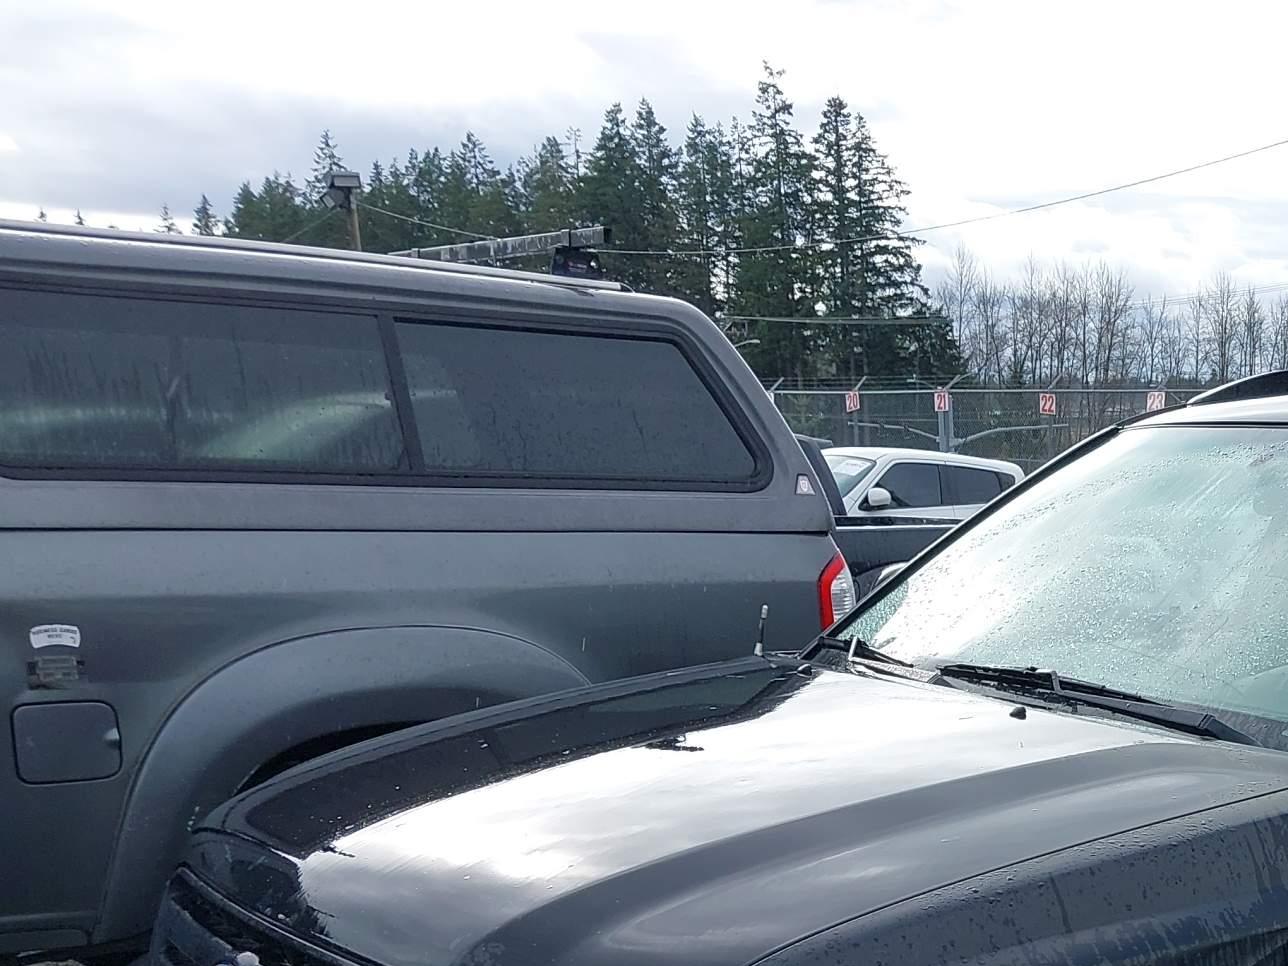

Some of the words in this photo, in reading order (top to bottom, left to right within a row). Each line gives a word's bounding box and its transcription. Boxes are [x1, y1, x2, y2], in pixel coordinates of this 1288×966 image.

[847, 393, 858, 410] 20
[936, 393, 947, 411] 21
[1041, 395, 1054, 413] 22
[1148, 393, 1164, 411] 23
